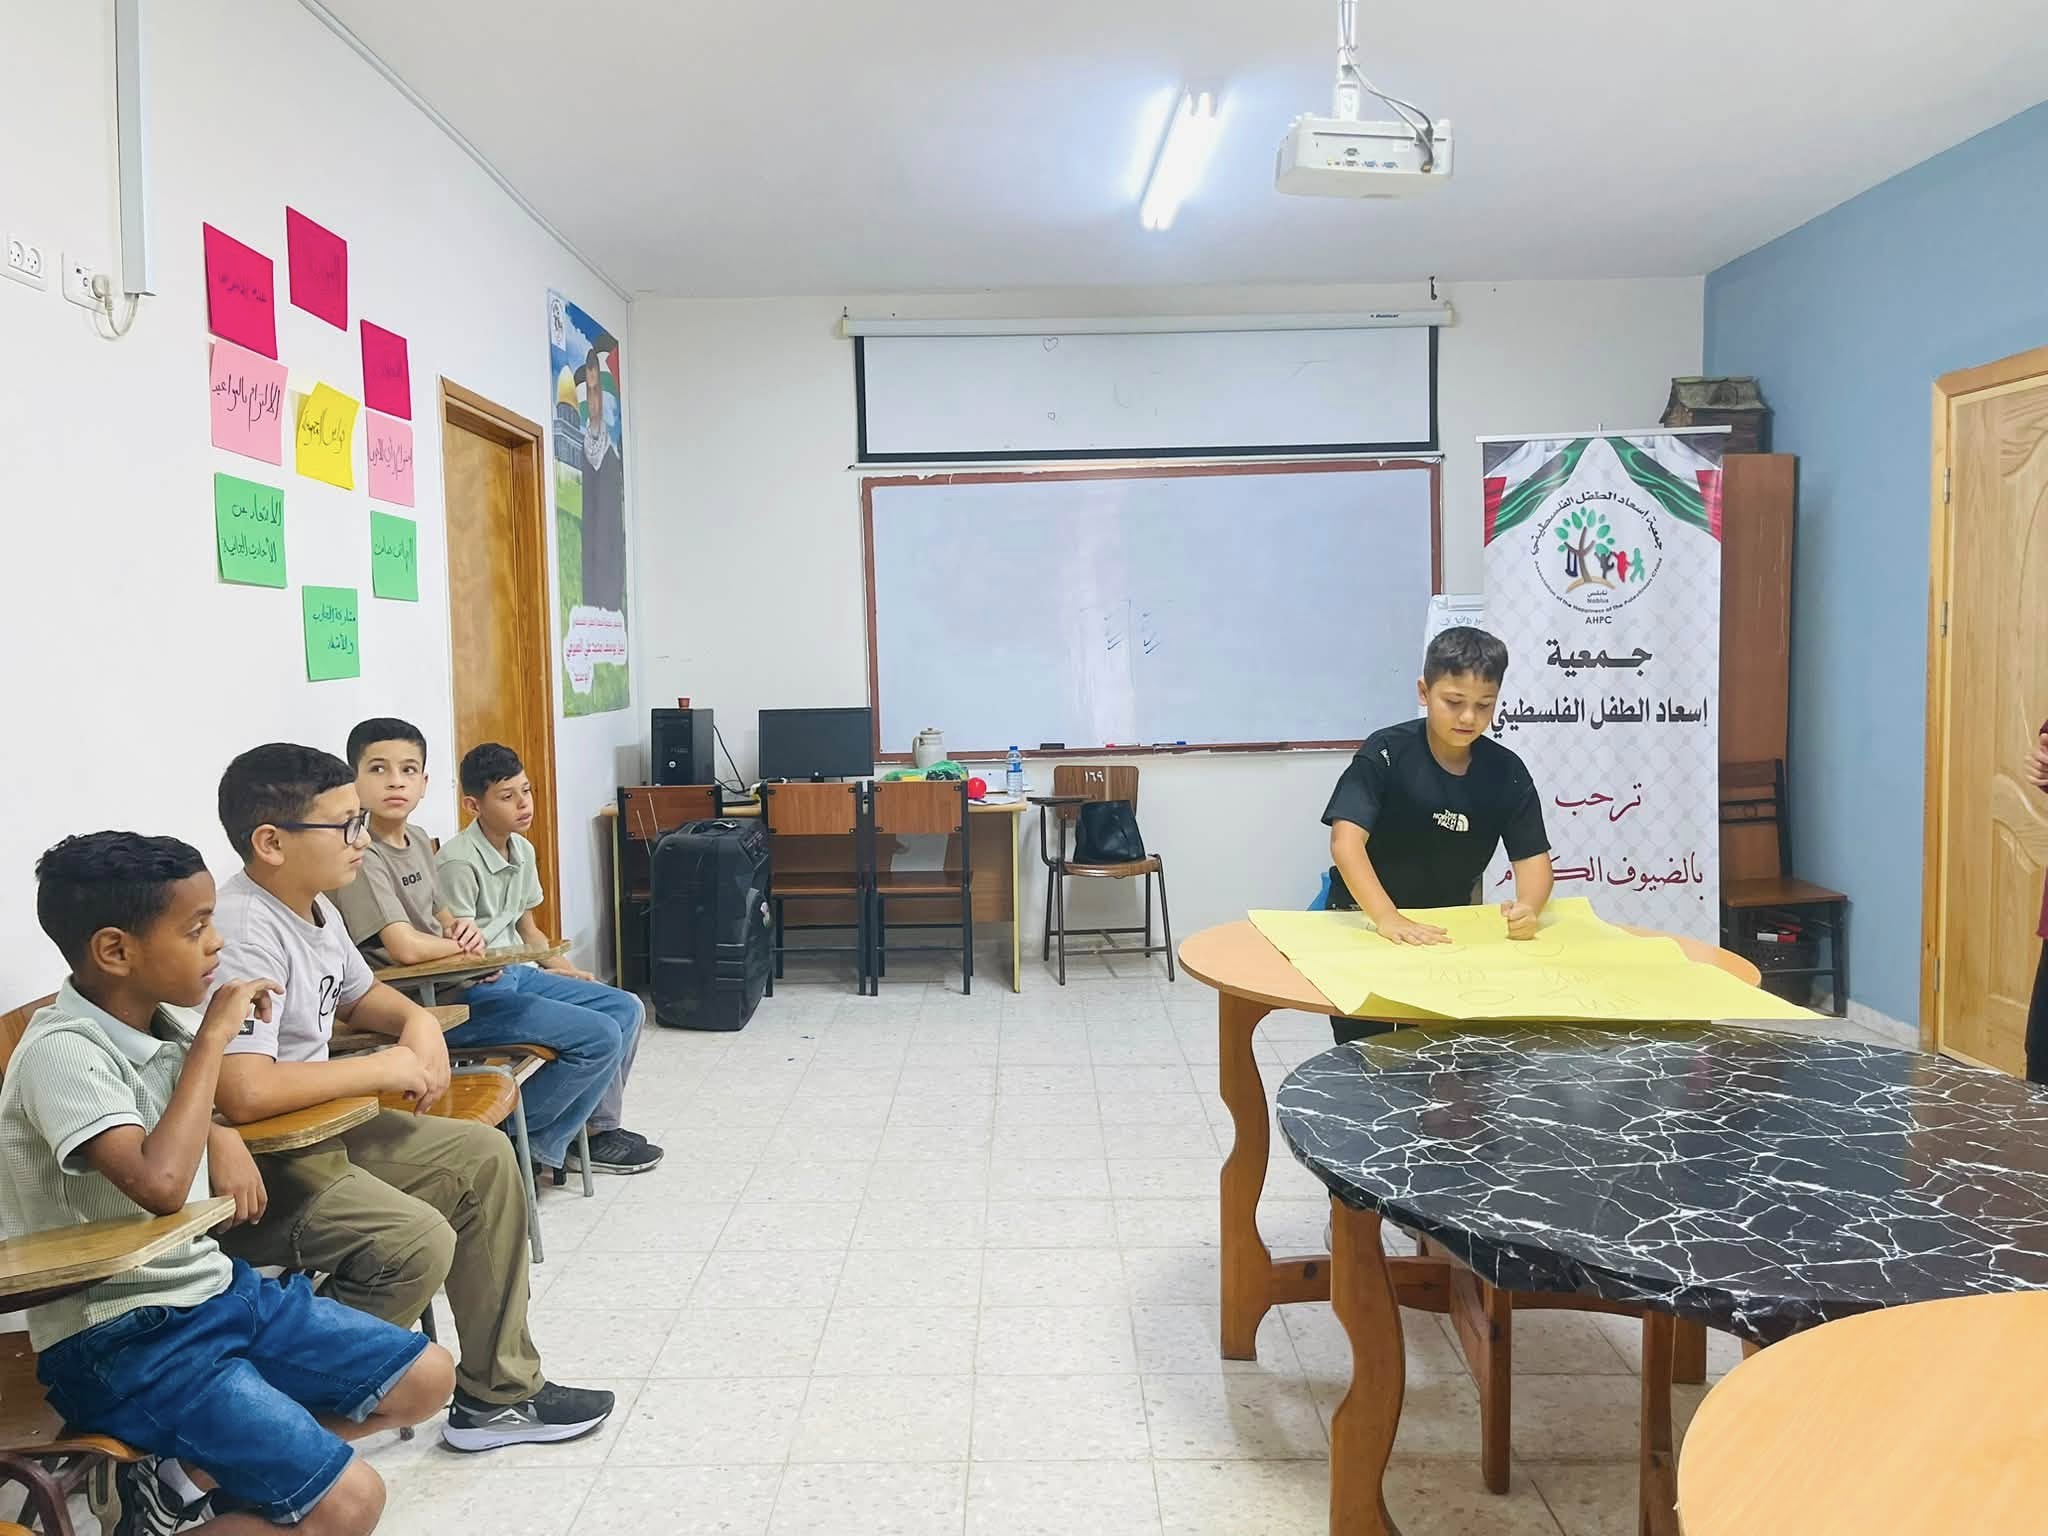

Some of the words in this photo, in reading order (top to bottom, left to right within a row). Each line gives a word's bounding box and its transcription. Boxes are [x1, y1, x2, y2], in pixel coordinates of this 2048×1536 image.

[1575, 490, 1617, 505] الطفل
[1616, 497, 1650, 520] إسعاد
[1530, 496, 1574, 556] الفلسطيني
[1646, 515, 1663, 550] جمعية
[1584, 615, 1613, 625] AHPC
[1546, 638, 1654, 678] جمعية
[1490, 695, 1586, 739] الفلسطيني
[1589, 694, 1650, 731] الطفل
[1655, 695, 1709, 728] إسعاد
[1554, 782, 1643, 823] ترحب
[1495, 855, 1603, 887] الكم
[1606, 851, 1705, 902] بالضيوف
